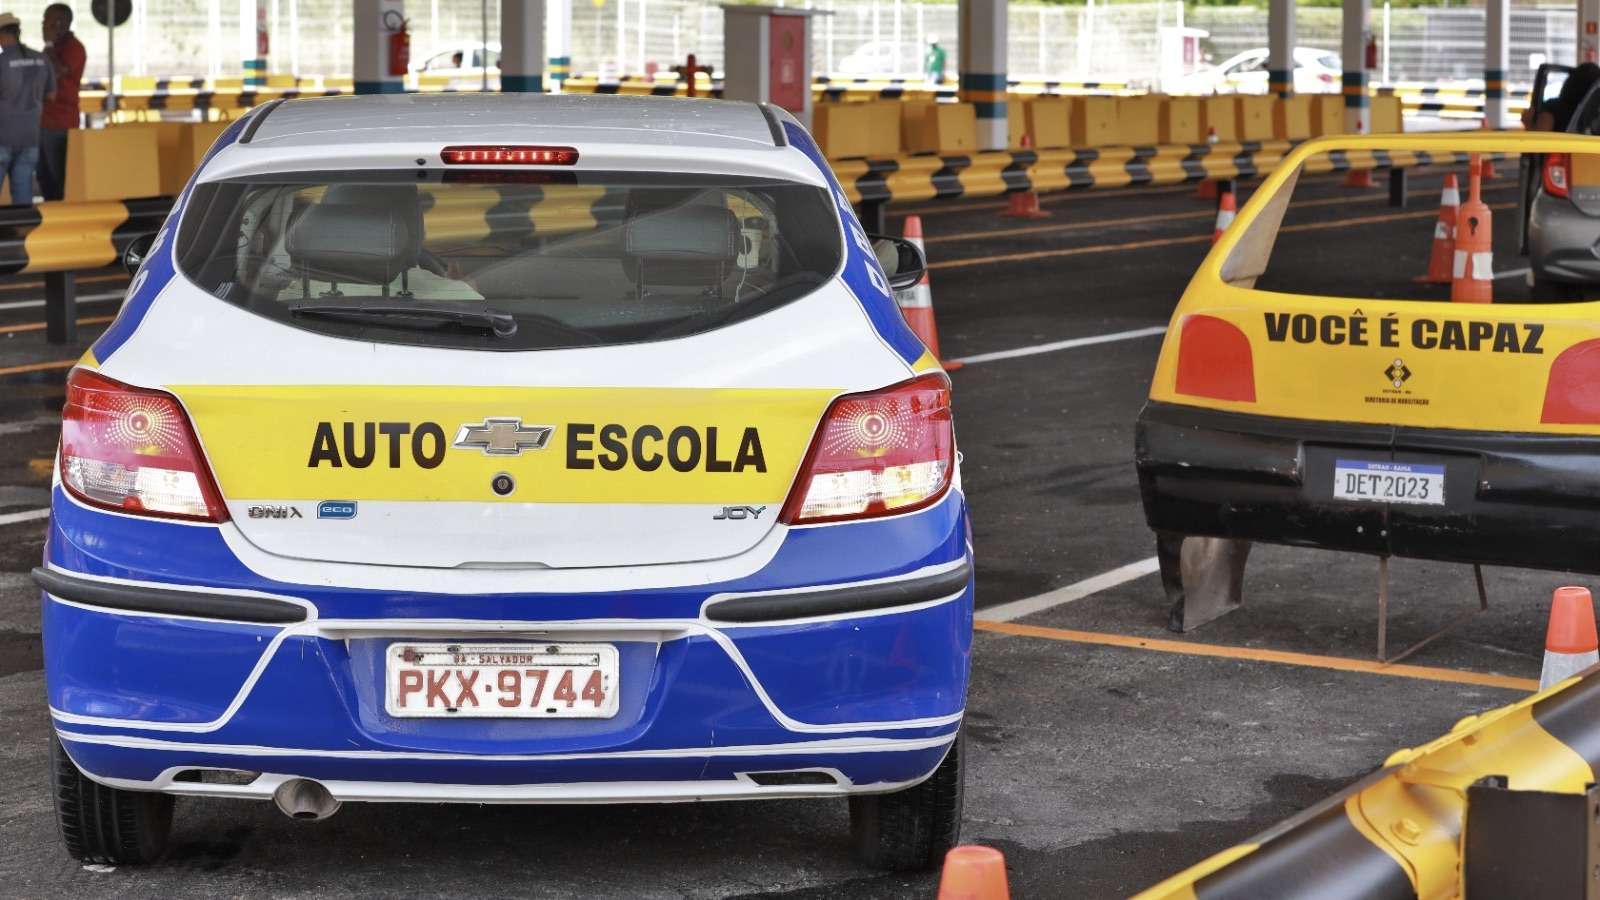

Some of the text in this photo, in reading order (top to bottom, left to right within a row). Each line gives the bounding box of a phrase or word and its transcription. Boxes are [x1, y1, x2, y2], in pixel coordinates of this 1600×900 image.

[1264, 308, 1545, 354] VOCÊ É CAPAZ
[307, 421, 447, 470] AUTO
[565, 423, 768, 473] ESCOLA
[1345, 473, 1430, 499] DET2023
[247, 505, 303, 519] ONIX
[322, 506, 353, 514] eco
[713, 506, 766, 520] JOY
[479, 654, 534, 664] SALVADOR
